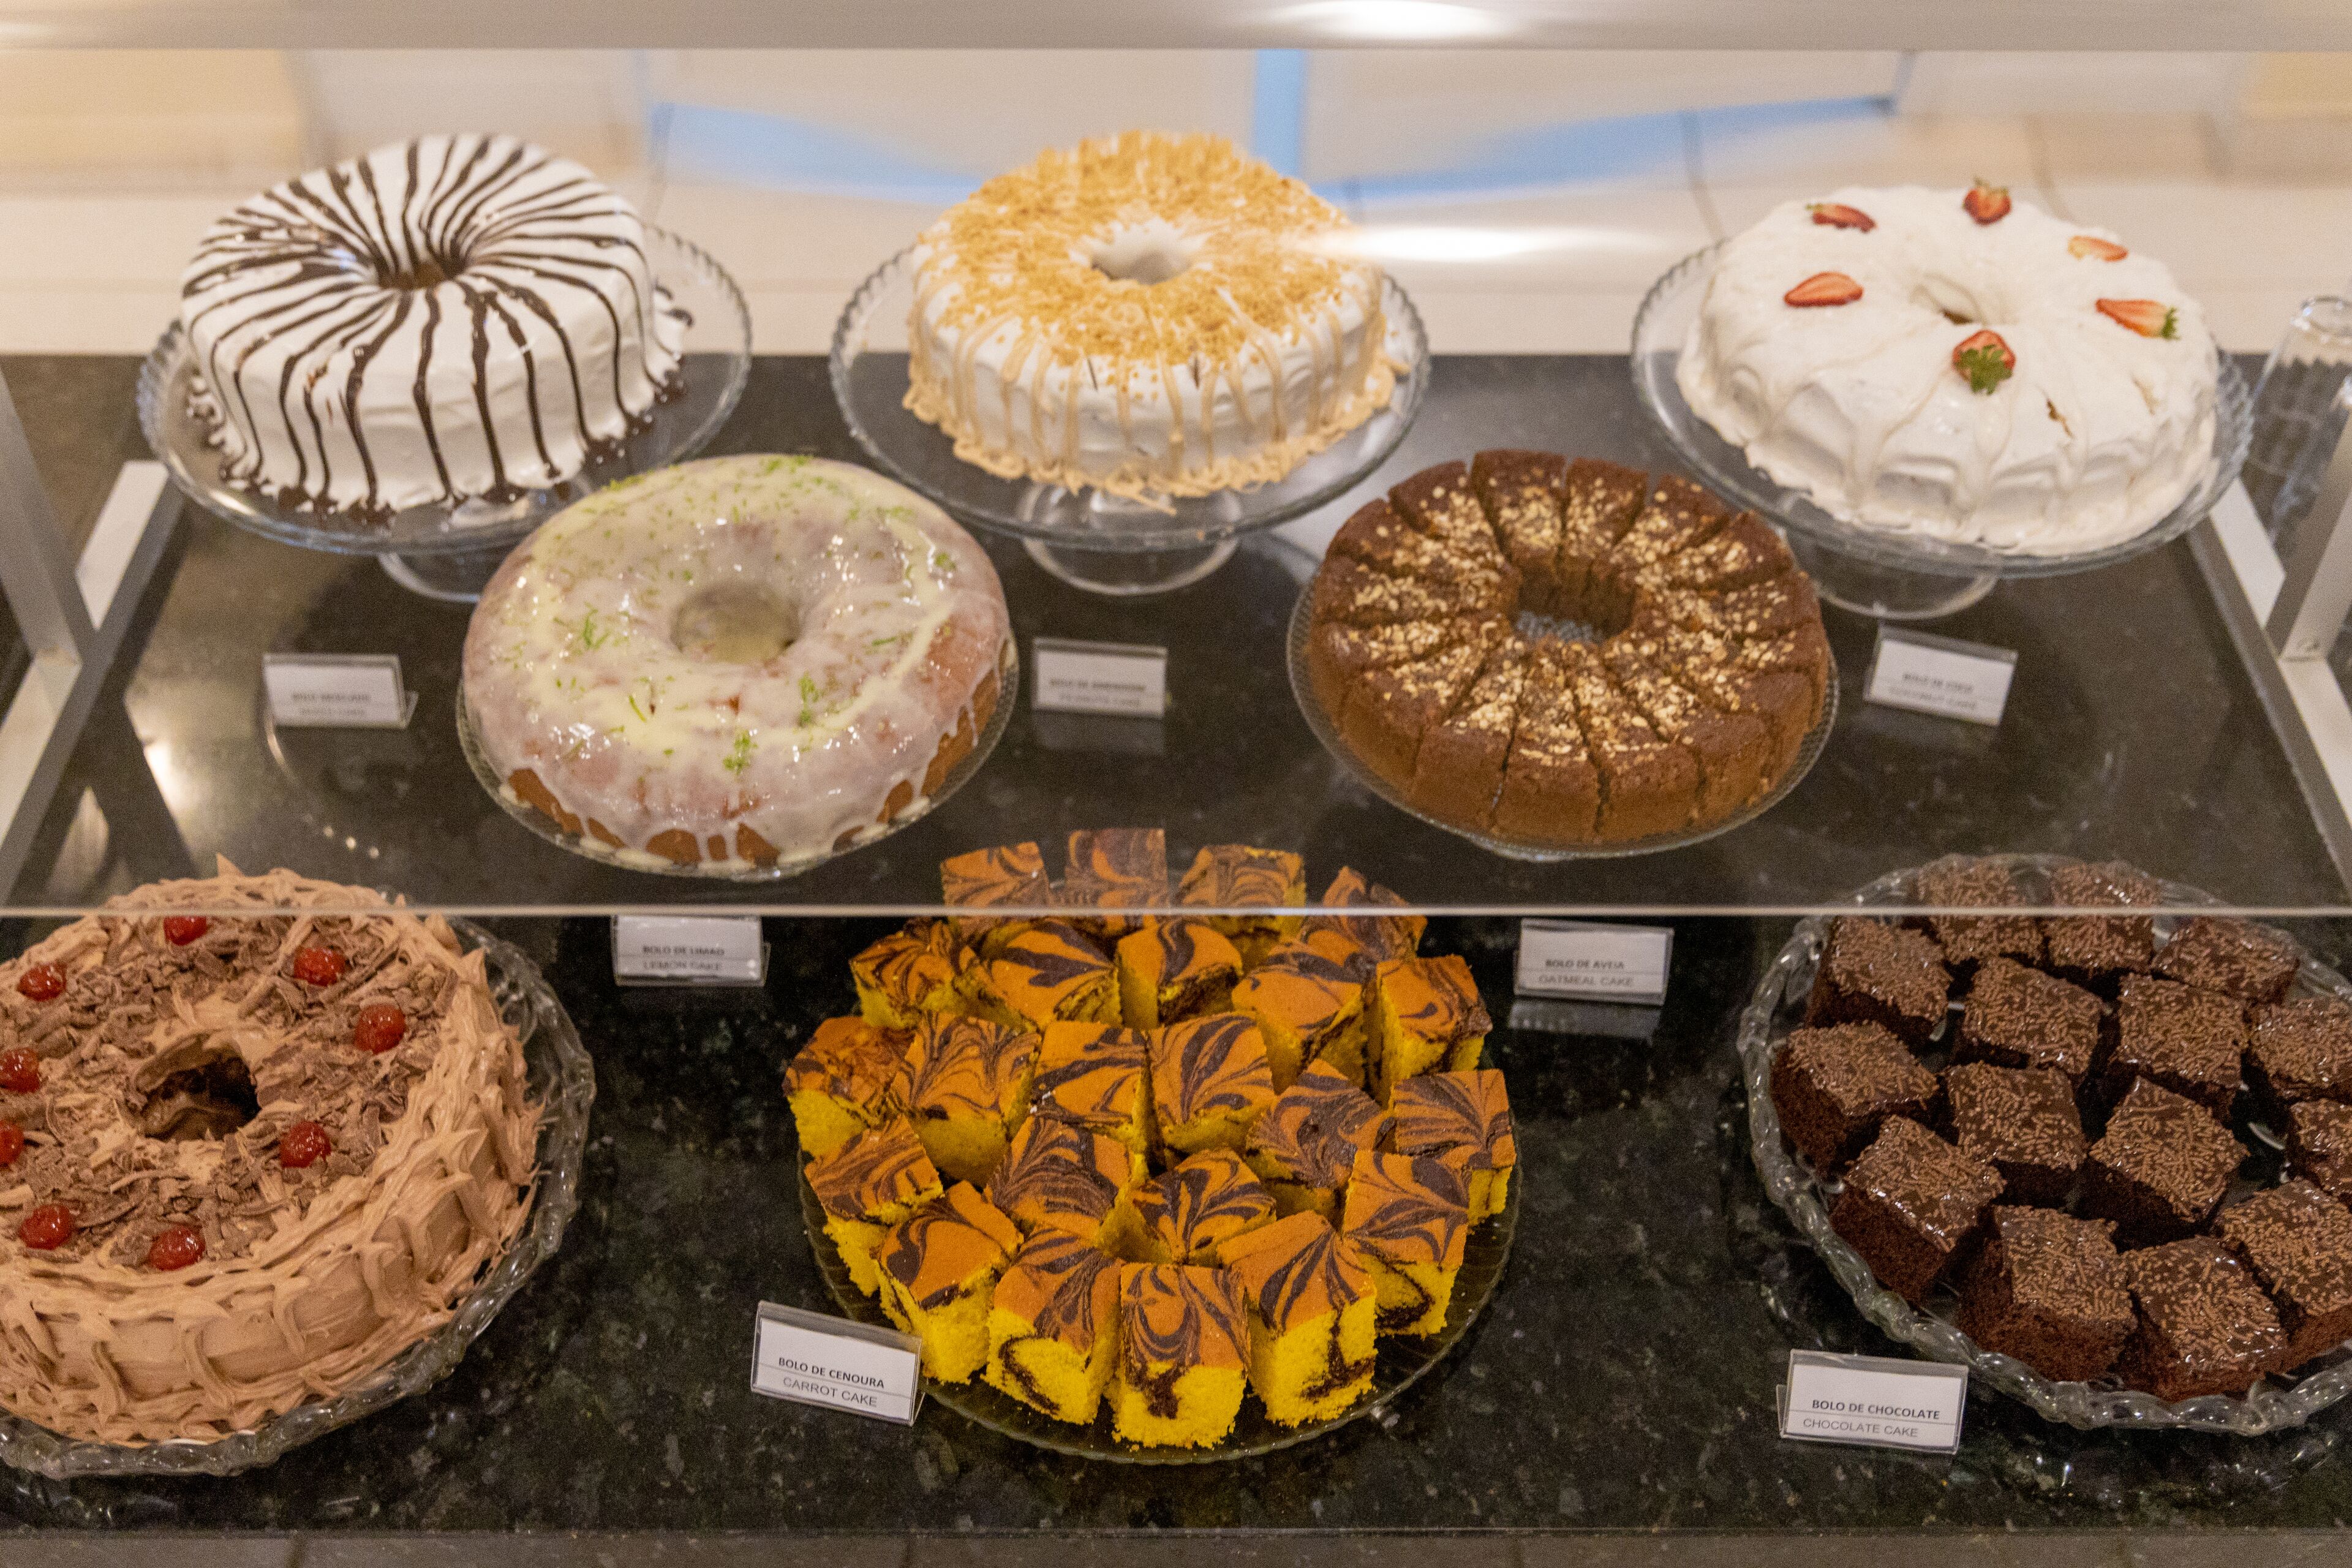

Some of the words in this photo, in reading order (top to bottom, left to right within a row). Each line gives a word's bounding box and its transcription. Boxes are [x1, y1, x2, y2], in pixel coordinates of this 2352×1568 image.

[1545, 959, 1574, 968] BOLO
[1577, 960, 1589, 968] DE
[1600, 976, 1634, 987] CAKE
[778, 1357, 808, 1372] BOLO
[812, 1365, 826, 1376] DE
[829, 1369, 884, 1389] CENOURA
[783, 1377, 838, 1398] CARROT
[842, 1390, 878, 1408] CAKE
[1812, 1399, 1845, 1410] BOLO
[1849, 1403, 1864, 1413] DE
[1868, 1404, 1940, 1420] CHOCOLATE
[1803, 1417, 1882, 1434] CHOCOLATE
[1884, 1425, 1918, 1438] CAKE
